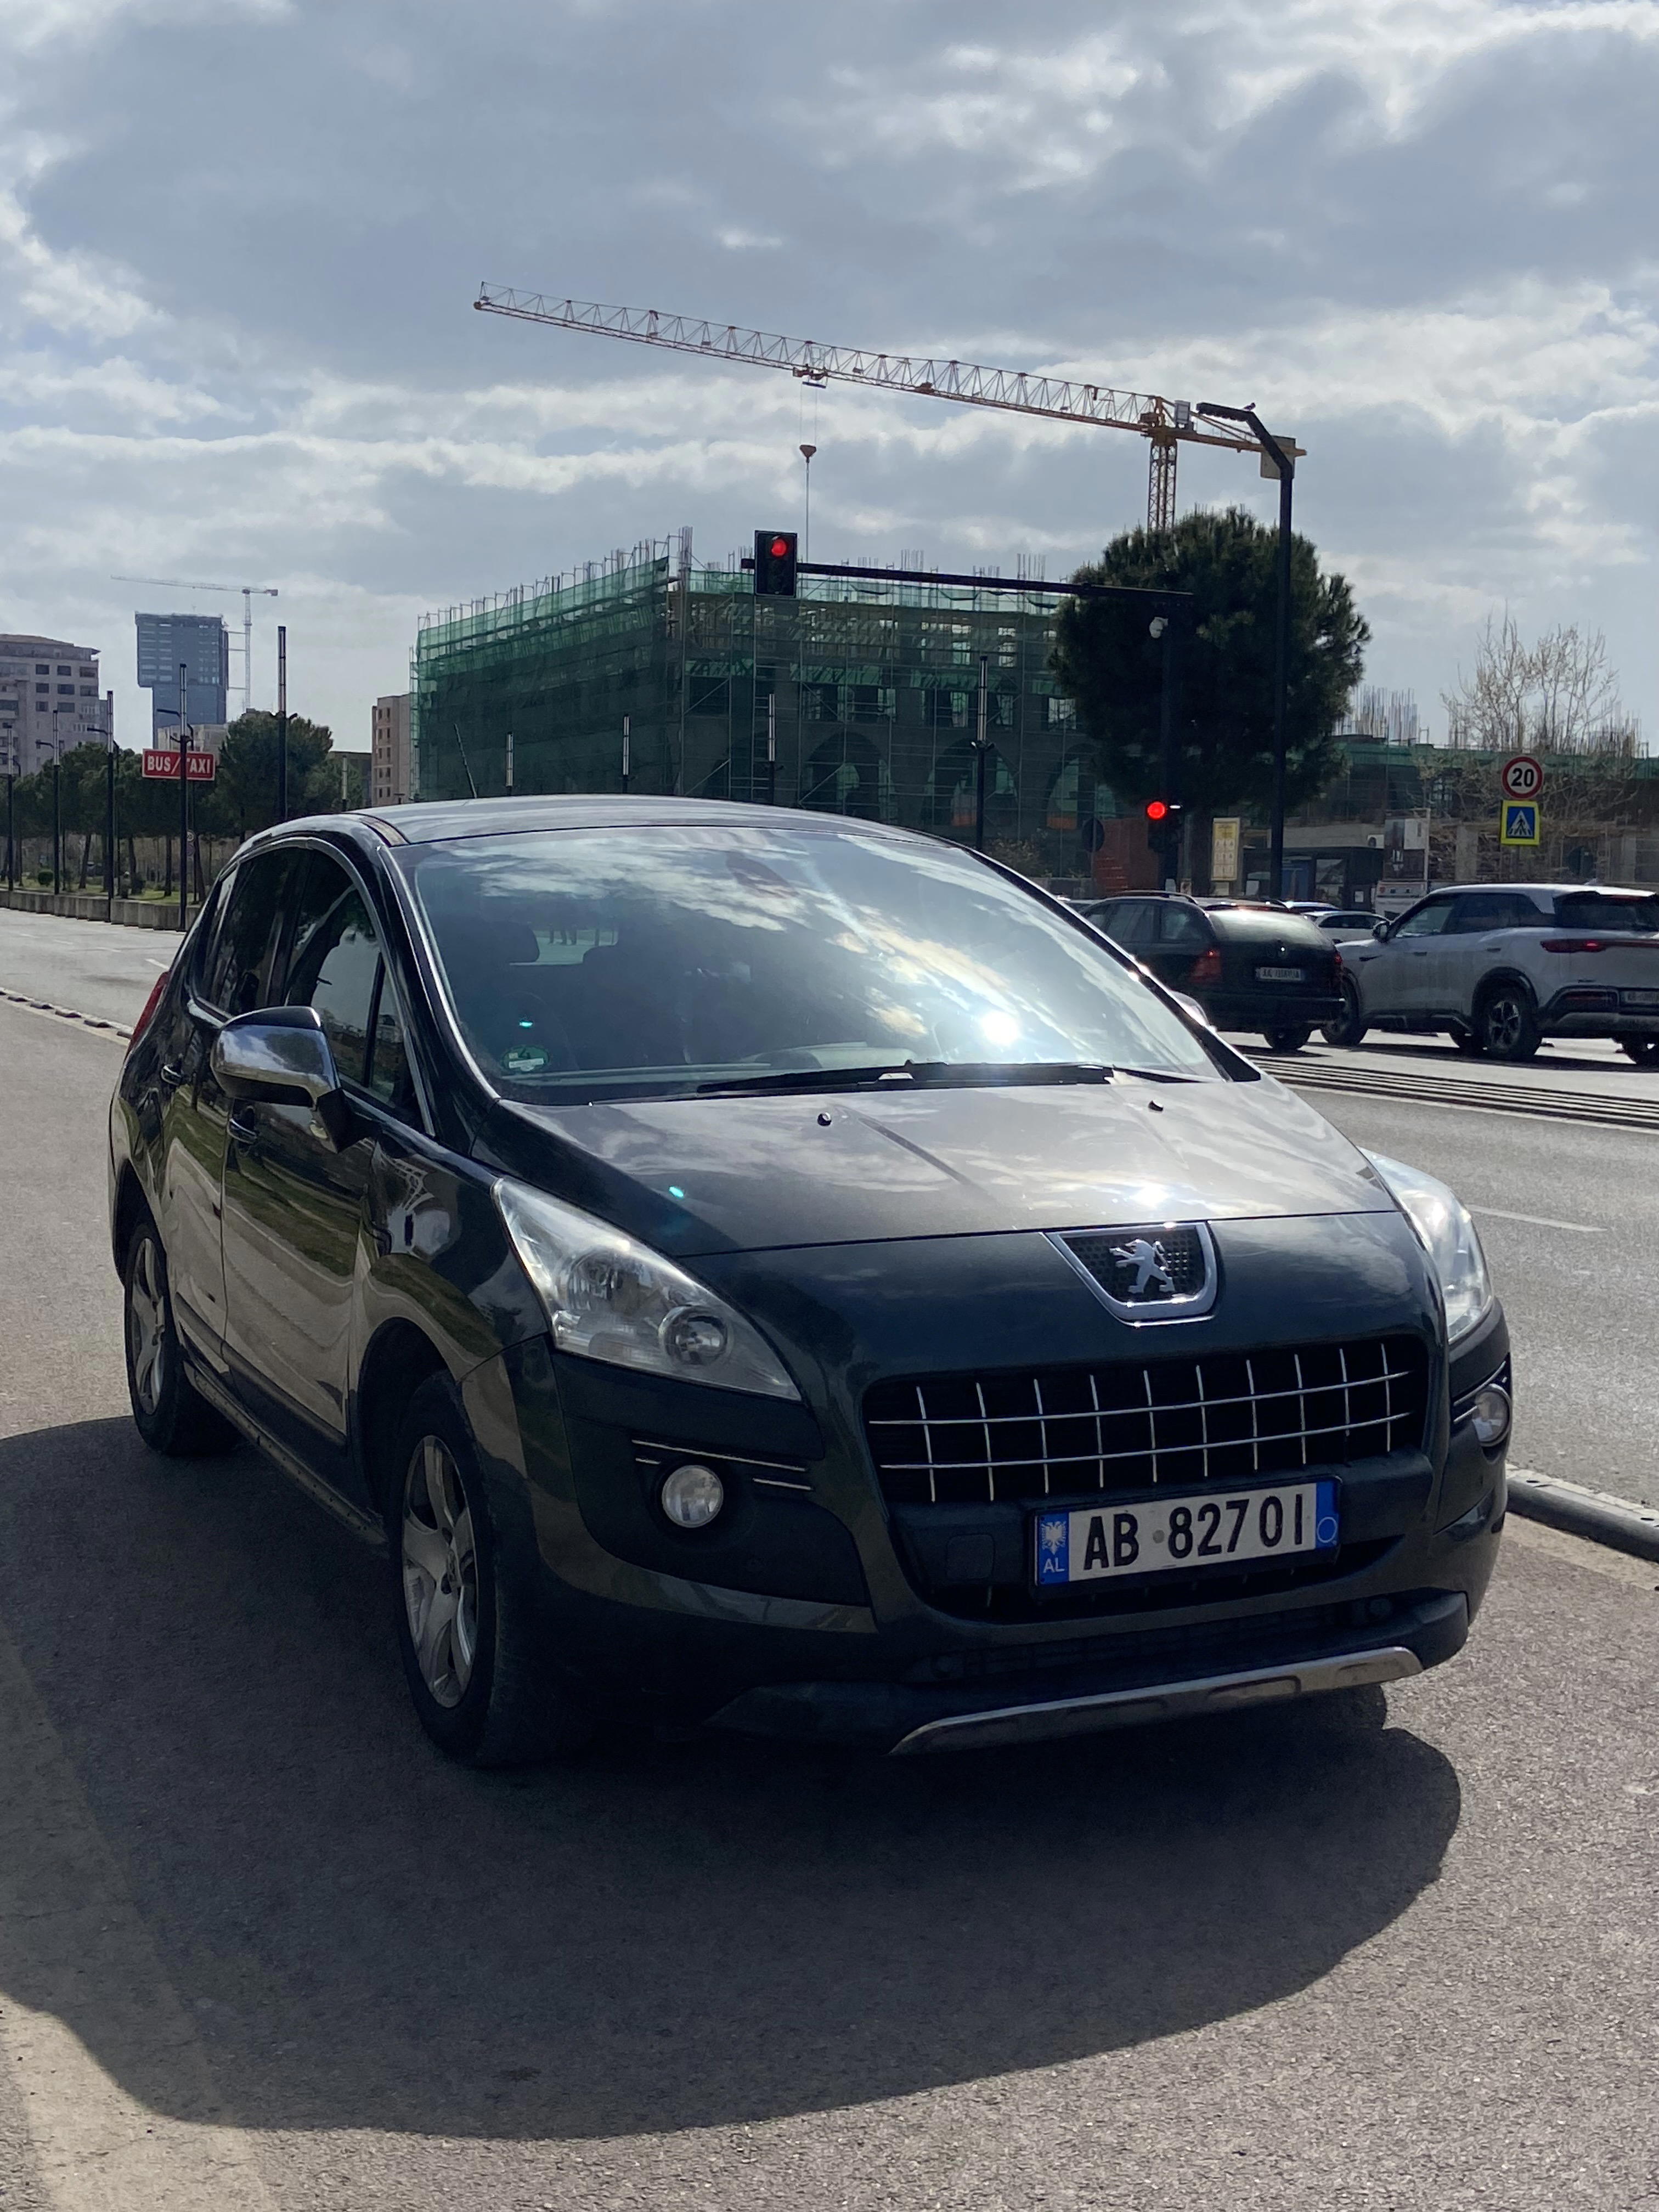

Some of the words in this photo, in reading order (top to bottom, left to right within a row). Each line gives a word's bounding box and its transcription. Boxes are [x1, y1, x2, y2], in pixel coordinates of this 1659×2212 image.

[1511, 768, 1534, 787] 20
[1084, 1513, 1139, 1570] AB
[1043, 1558, 1065, 1573] AL
